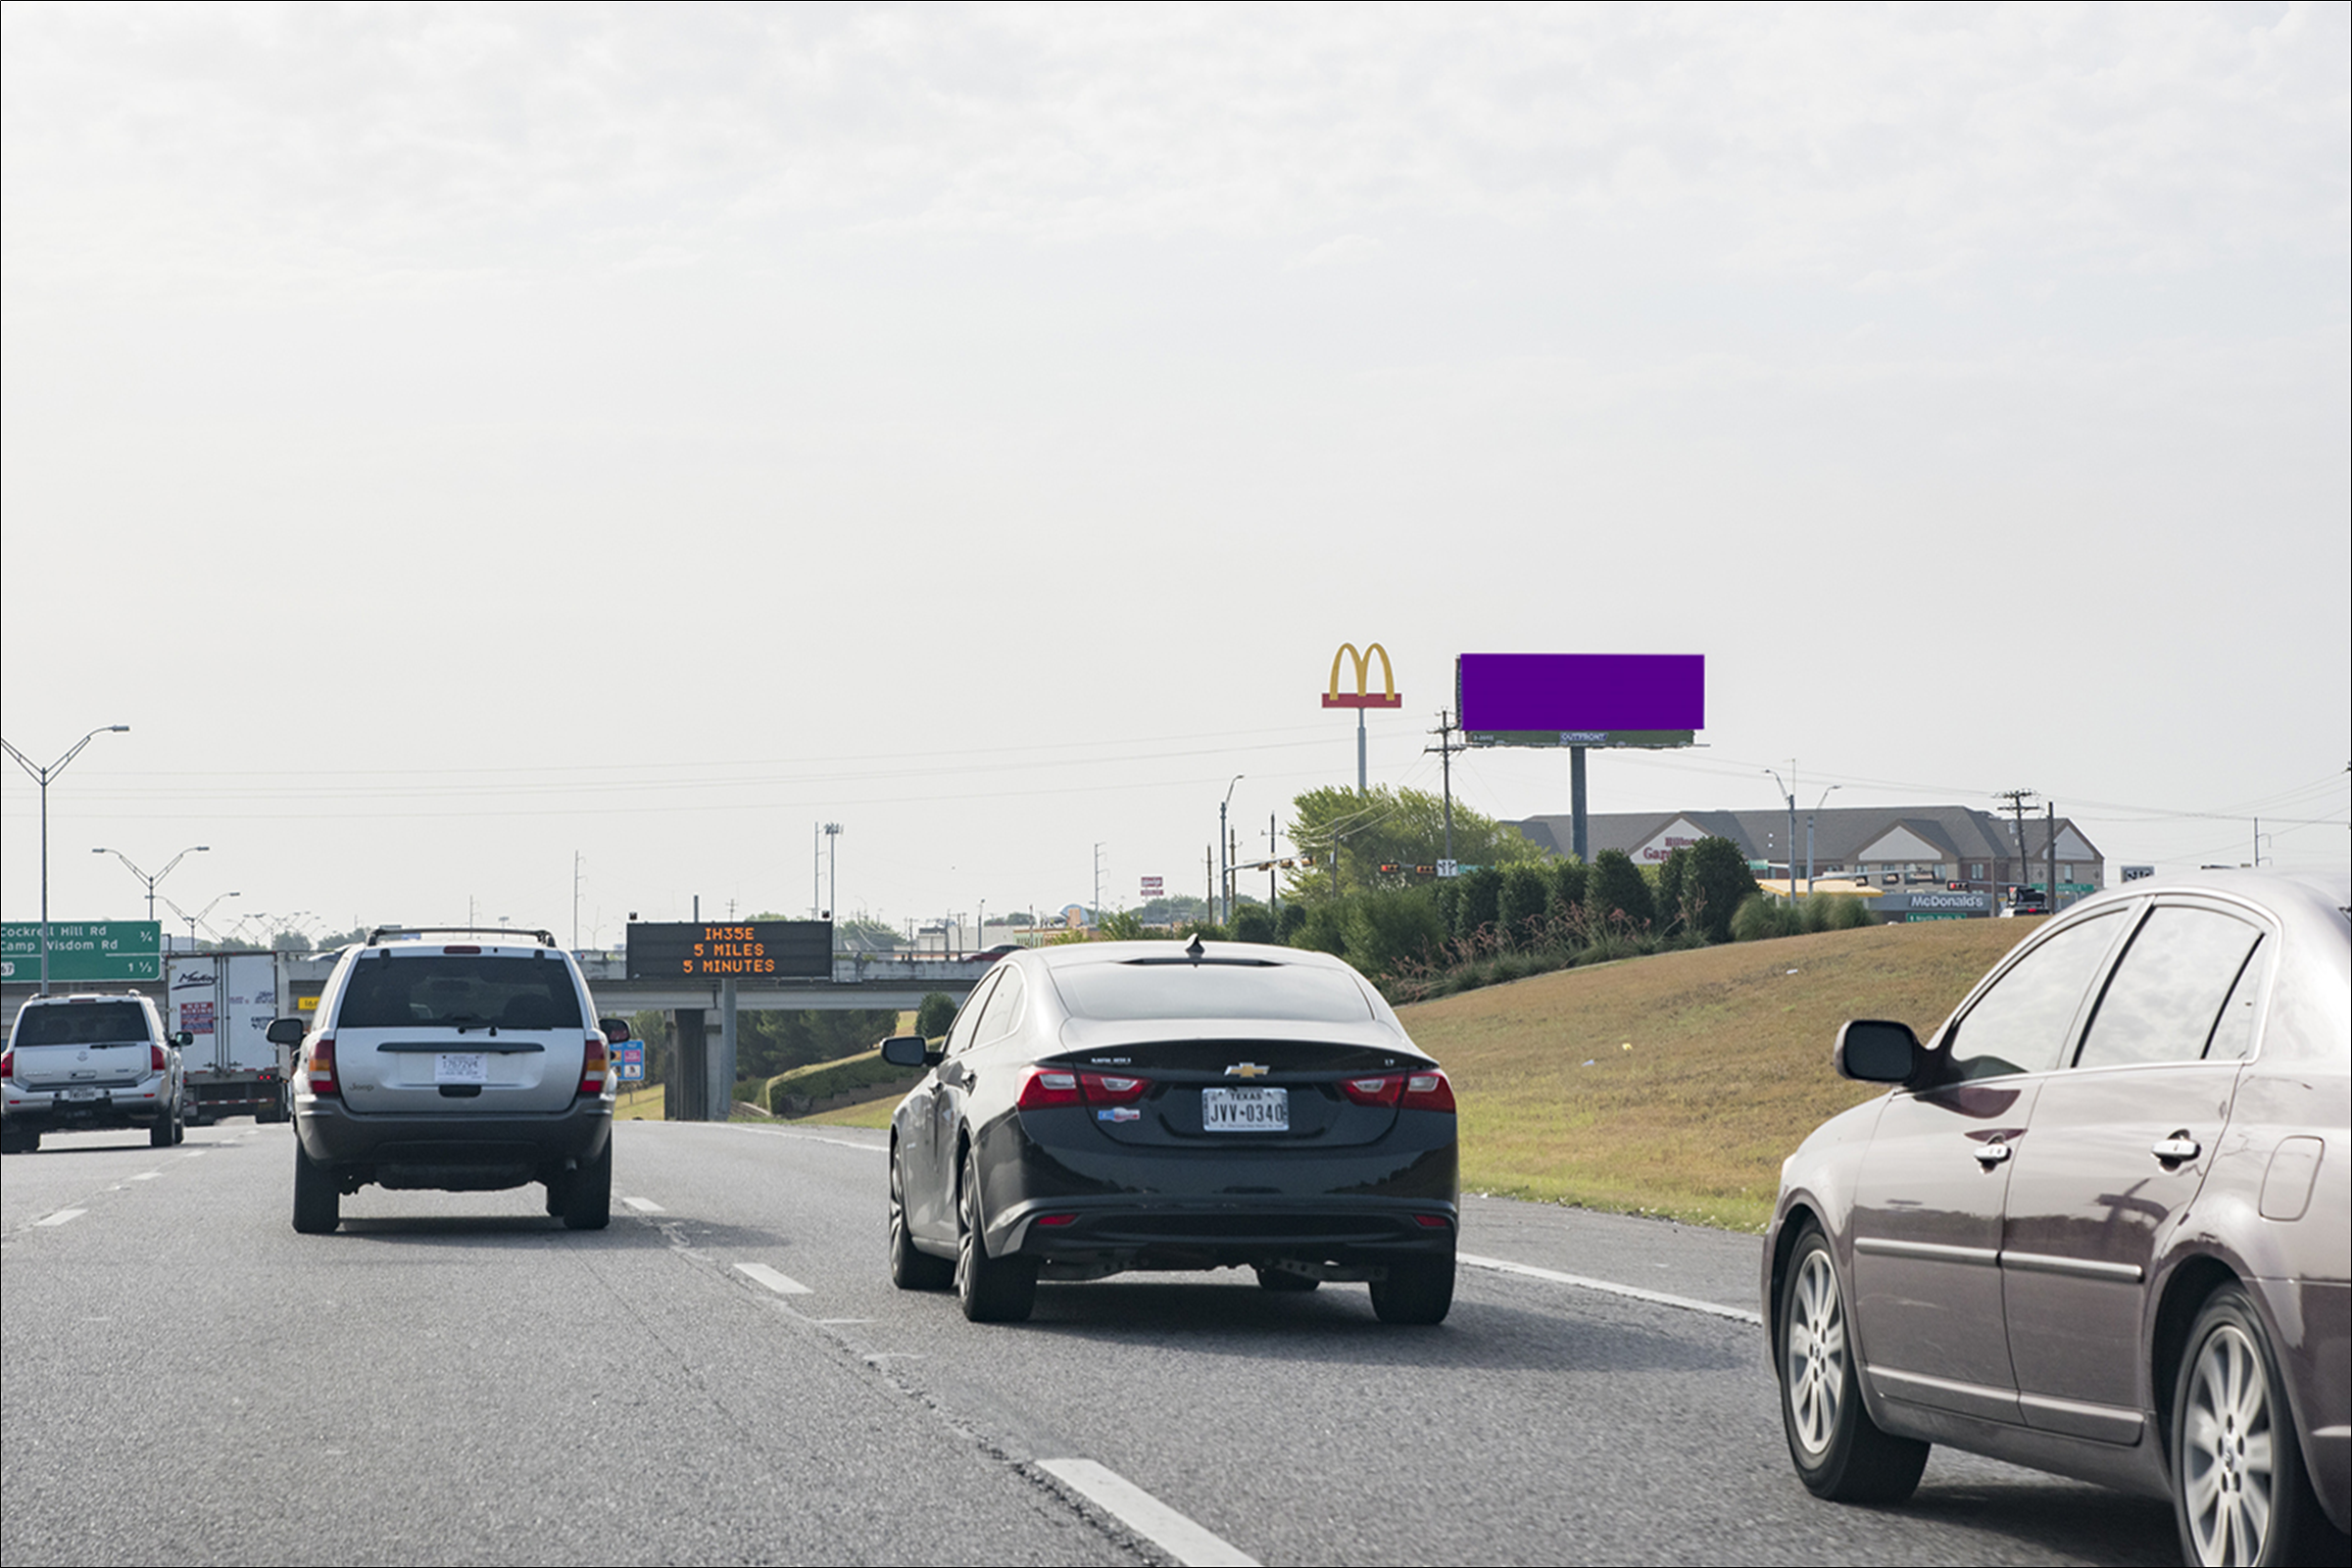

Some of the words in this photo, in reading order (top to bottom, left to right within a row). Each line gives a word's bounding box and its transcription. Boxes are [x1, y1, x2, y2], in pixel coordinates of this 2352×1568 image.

[1911, 896, 1984, 907] McDonald's
[61, 927, 83, 937] Hill
[90, 926, 107, 936] Rd
[705, 927, 755, 941] IH35E
[1, 941, 35, 953] Camp
[101, 940, 119, 950] Rd
[694, 944, 705, 956] 5
[713, 943, 764, 956] MILES
[128, 962, 134, 972] 1
[683, 959, 694, 973] 5
[703, 958, 775, 973] MINUTES
